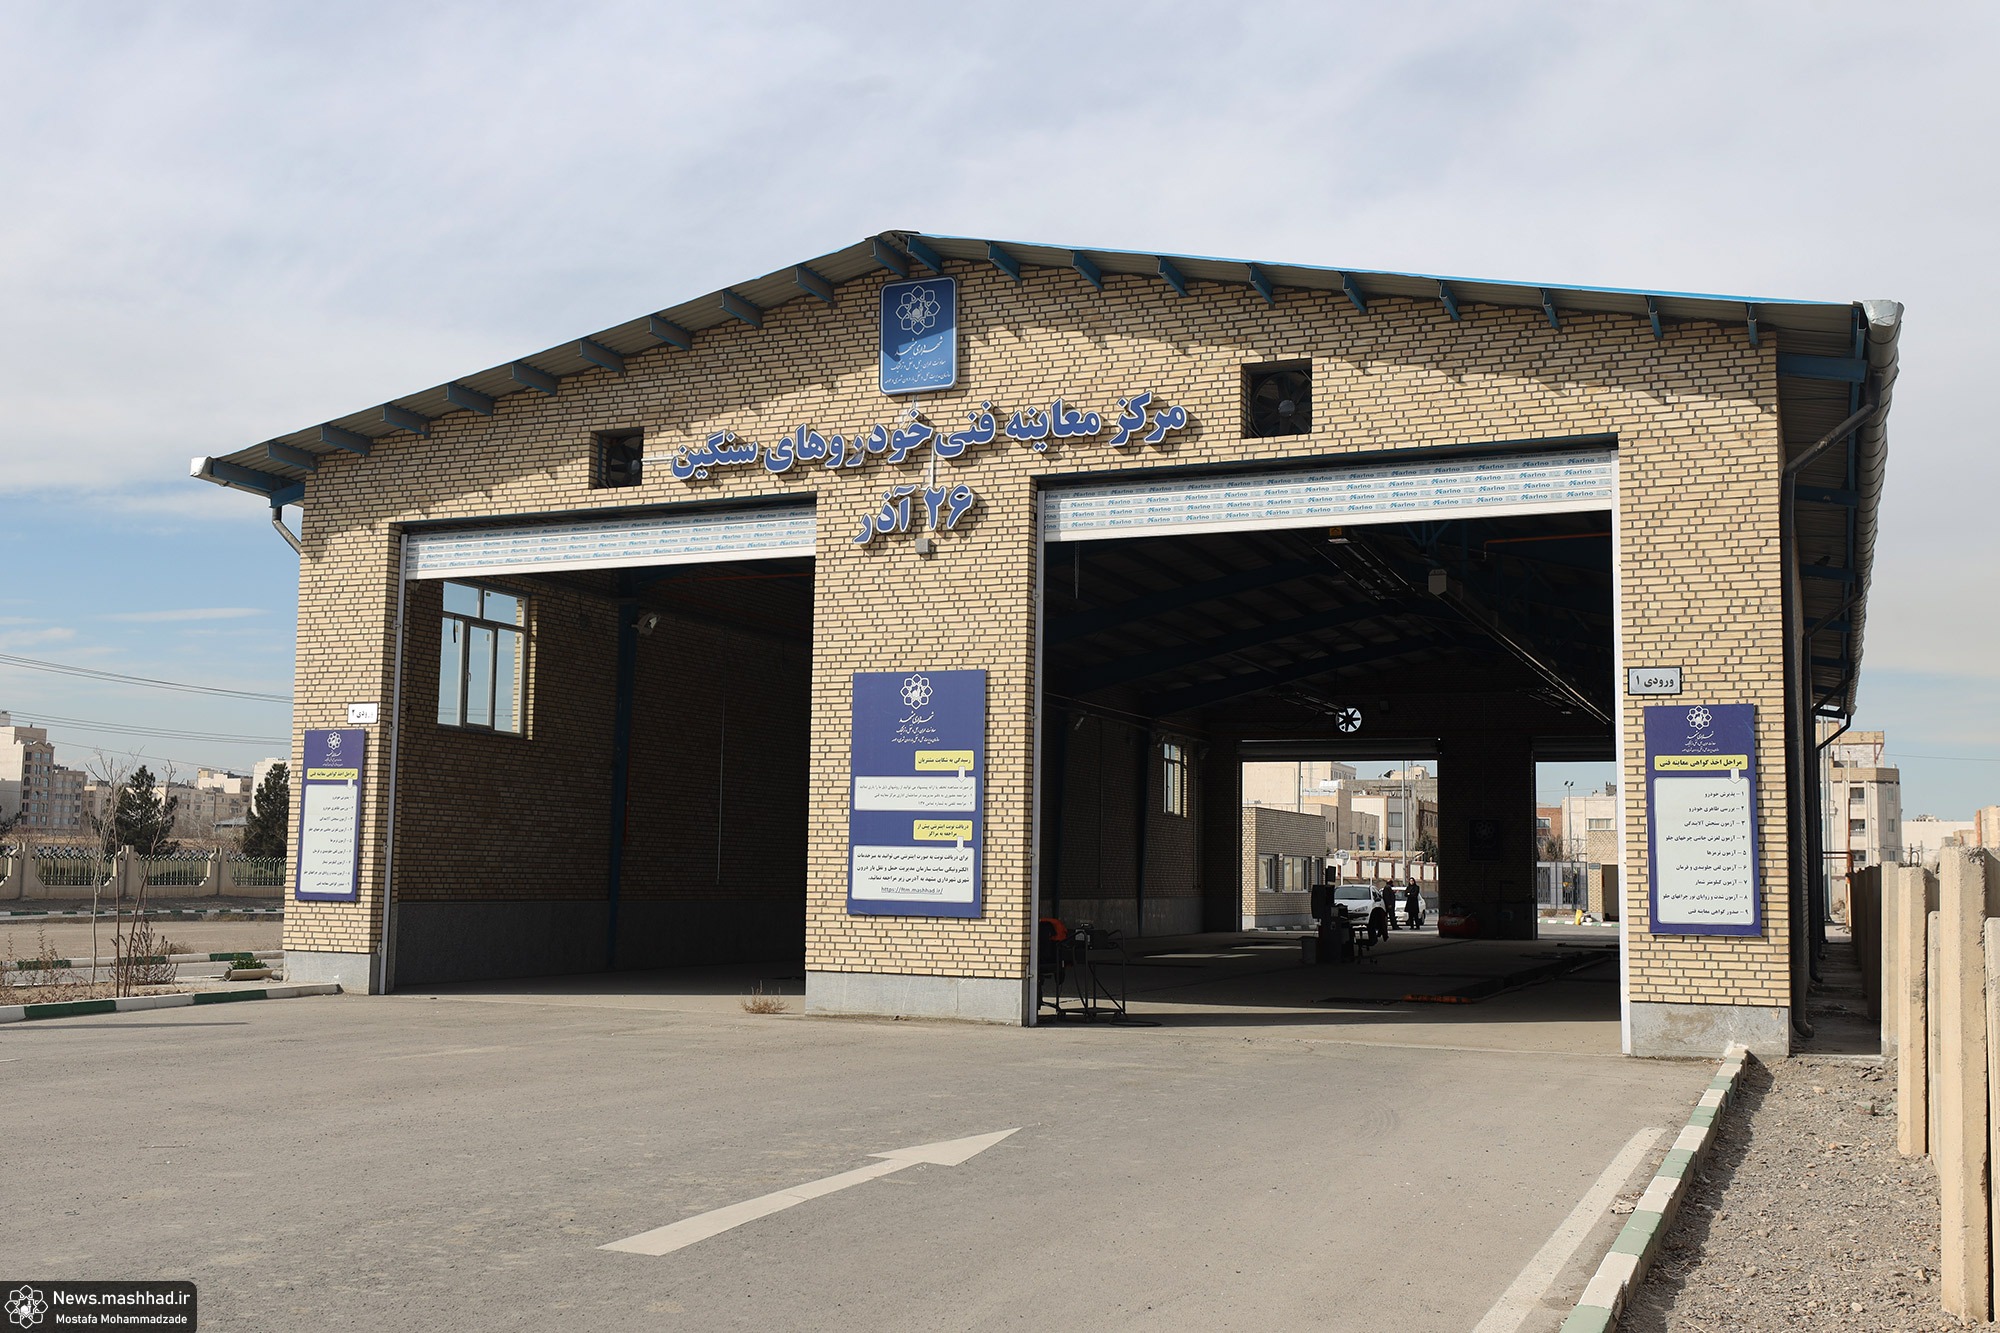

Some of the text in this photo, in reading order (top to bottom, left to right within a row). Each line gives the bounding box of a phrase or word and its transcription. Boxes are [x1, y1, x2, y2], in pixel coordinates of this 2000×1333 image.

[934, 400, 997, 458] فنی
[1004, 398, 1101, 451] معاینه
[1108, 391, 1187, 446] مرکز
[671, 429, 758, 479] سنگین
[853, 484, 975, 544] ۲۶ آذر
[1643, 676, 1674, 688] ورودی
[1659, 759, 1671, 767] فنی
[1690, 759, 1709, 767] گواهی
